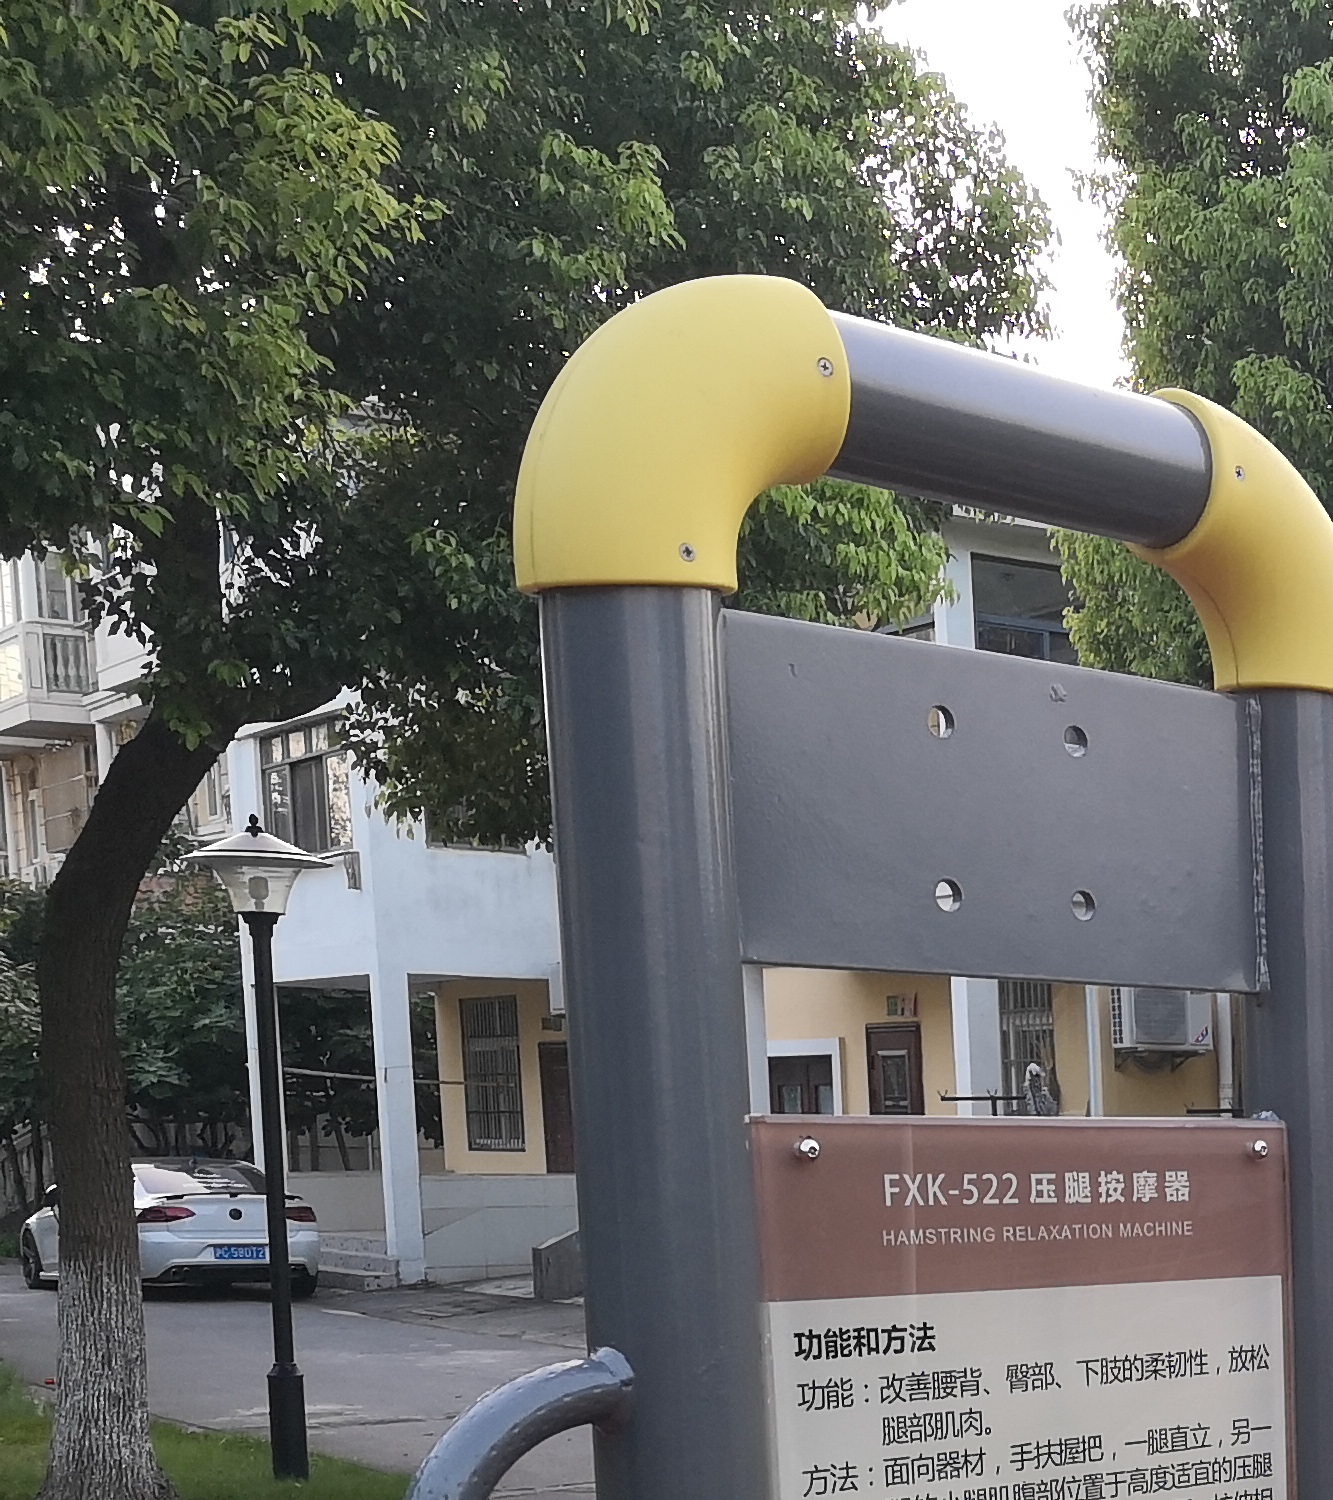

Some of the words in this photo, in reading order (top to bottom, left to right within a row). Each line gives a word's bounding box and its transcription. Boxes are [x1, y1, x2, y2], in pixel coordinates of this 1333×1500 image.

[883, 1170, 1019, 1209] FXK-522
[1029, 1170, 1190, 1204] 压腿按摩器
[882, 1226, 996, 1246] HAMSTRING
[1003, 1223, 1113, 1242] RELAXATION
[1119, 1220, 1193, 1238] MACHINE
[793, 1321, 937, 1362] 功能和方法
[882, 1406, 992, 1447] 腿部肌肉。
